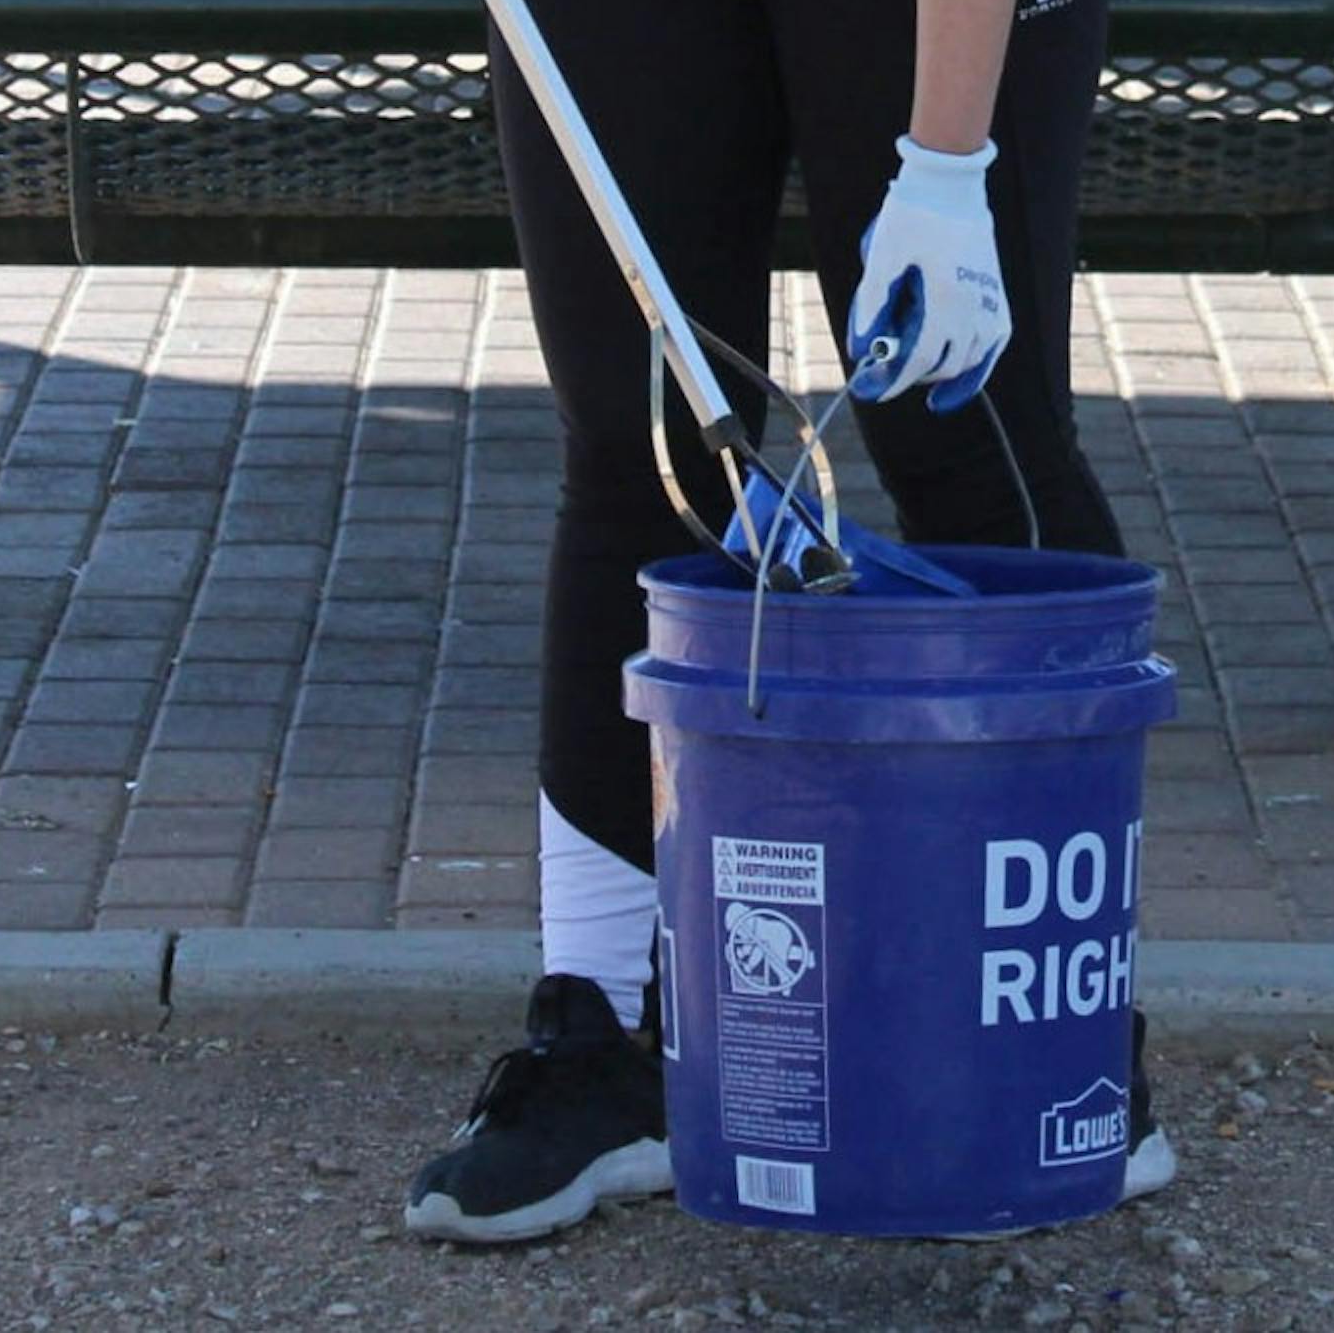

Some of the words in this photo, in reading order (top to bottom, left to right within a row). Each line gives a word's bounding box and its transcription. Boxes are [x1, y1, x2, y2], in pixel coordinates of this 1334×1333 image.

[735, 843, 817, 862] WARNING
[736, 863, 817, 881] AVERTISSEMENT
[983, 830, 1107, 929] DO
[736, 881, 817, 899] ADVERTENCIA
